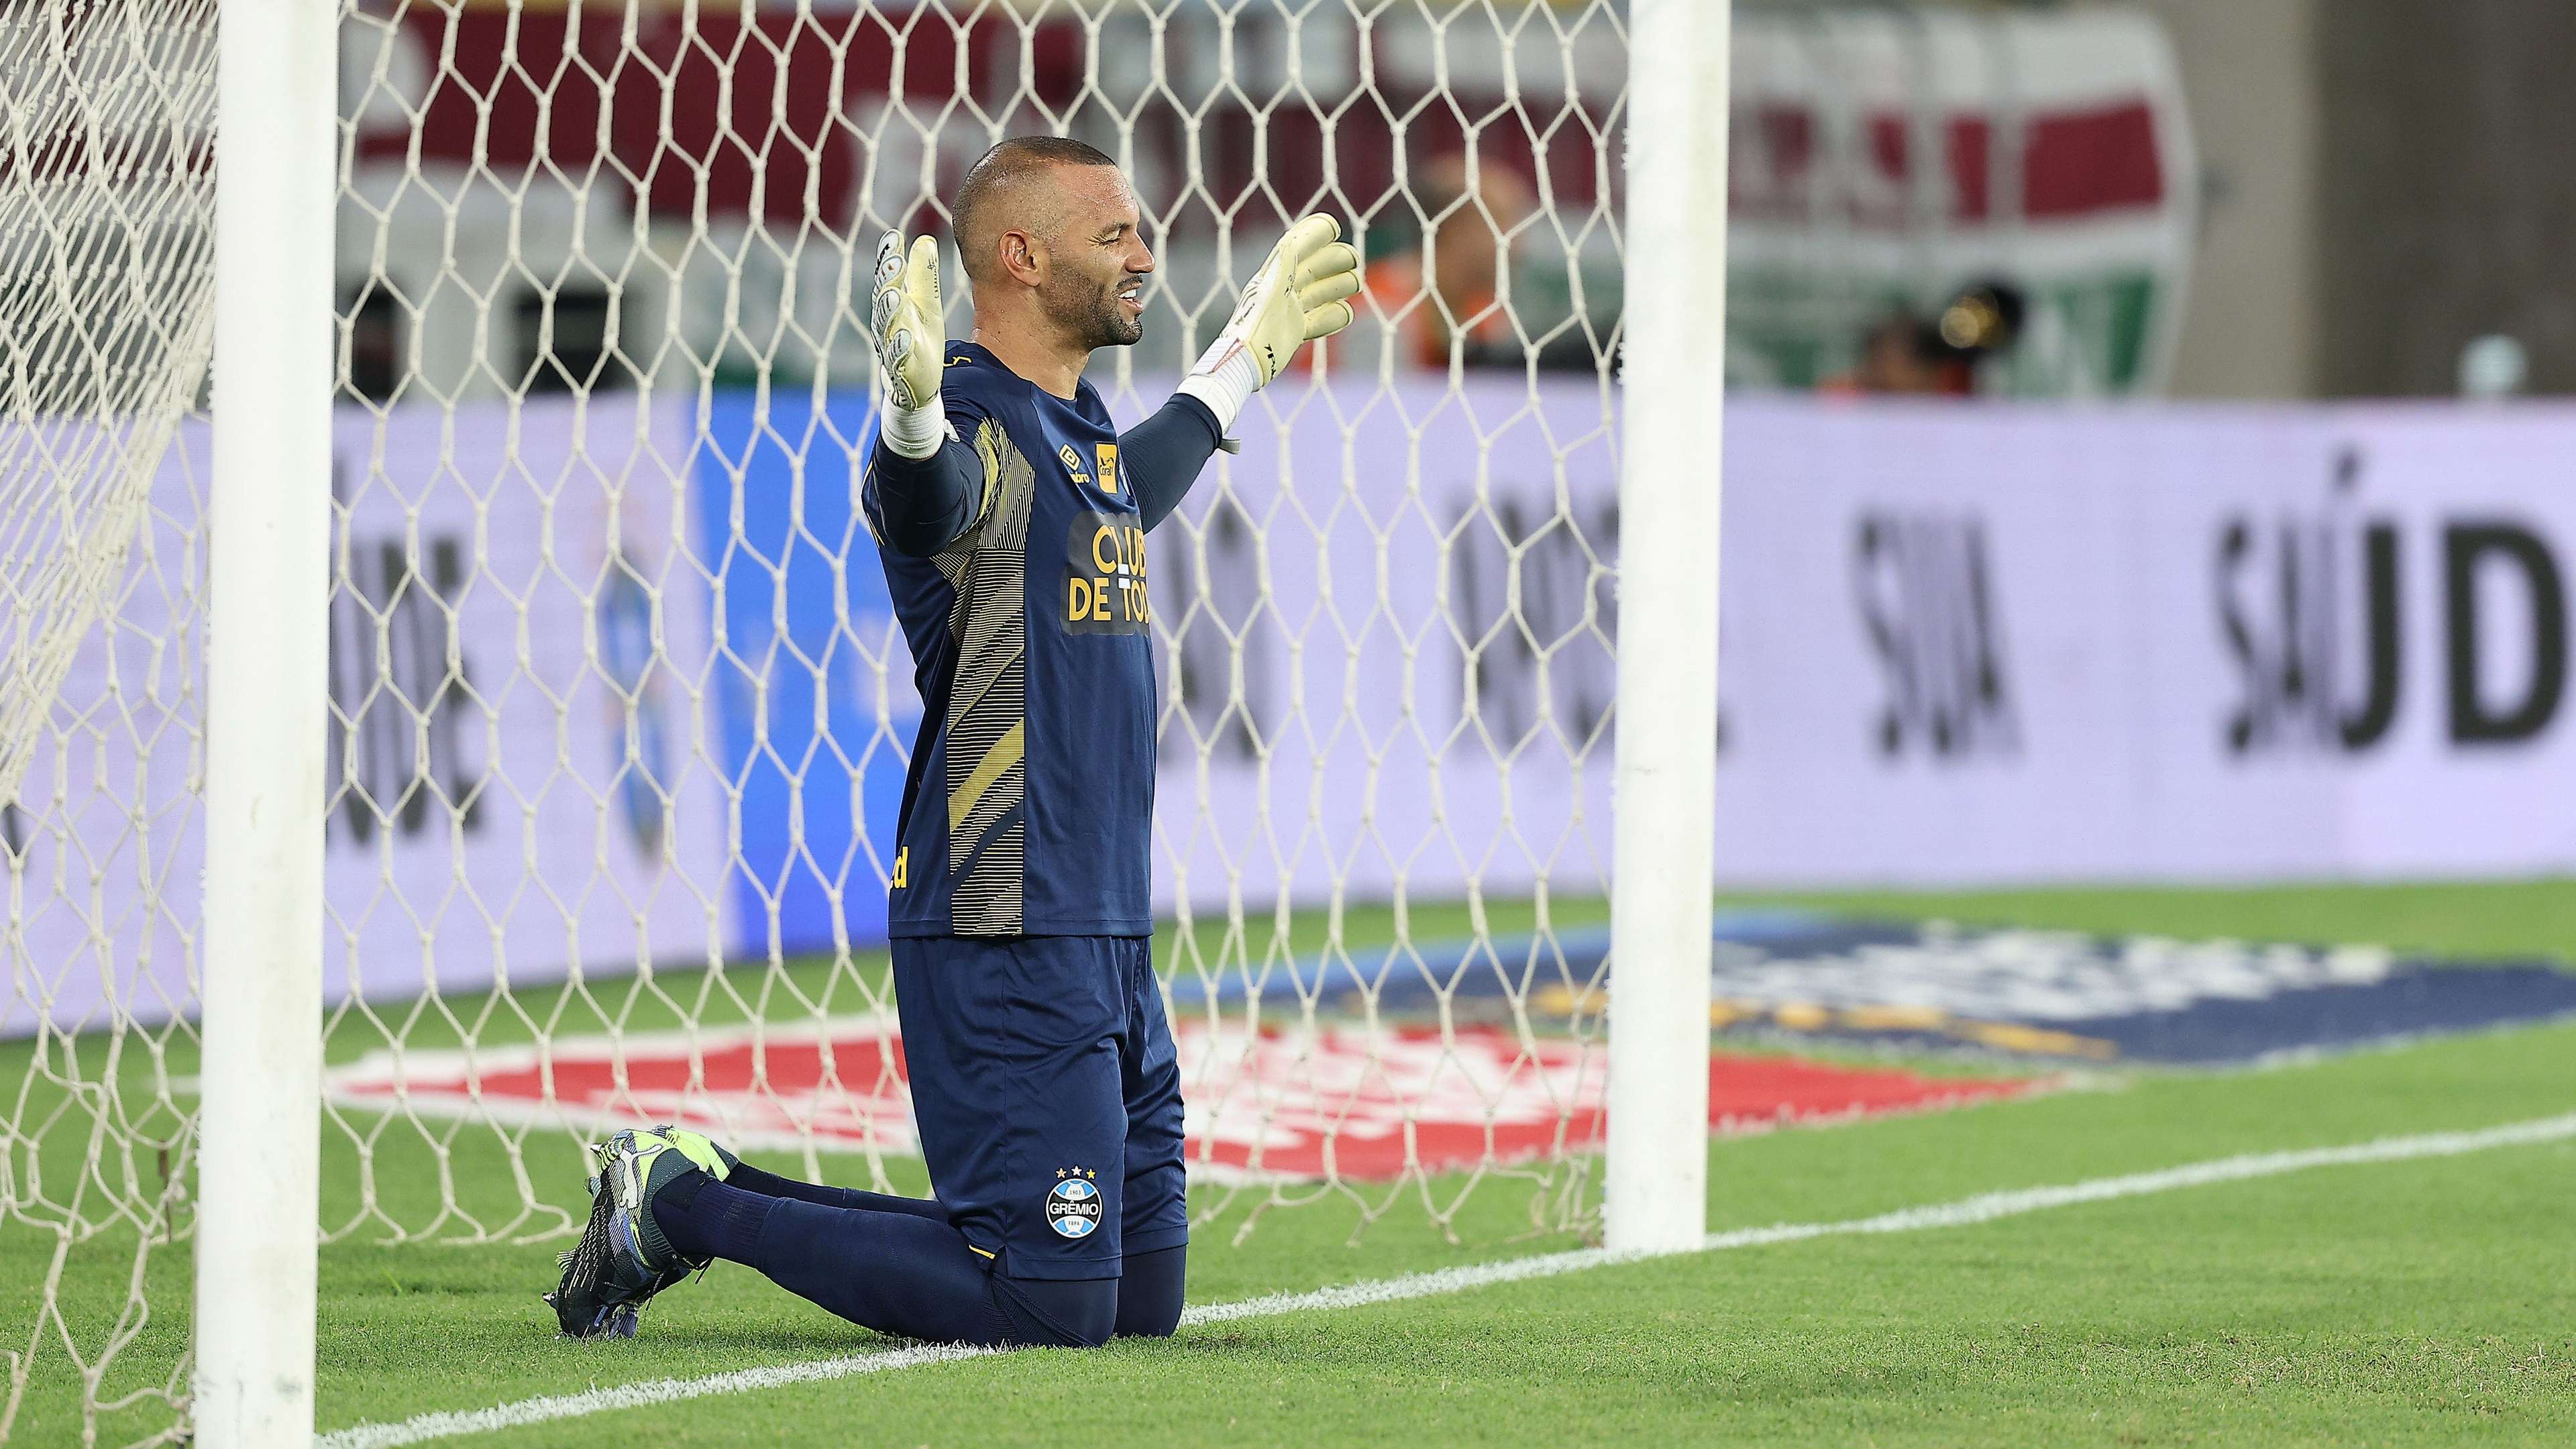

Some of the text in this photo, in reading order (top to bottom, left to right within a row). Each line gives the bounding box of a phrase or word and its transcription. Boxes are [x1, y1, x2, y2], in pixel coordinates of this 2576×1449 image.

[1099, 465, 1112, 476] Coral
[1069, 577, 1112, 621] DE
[1049, 1200, 1099, 1216] GRÊMIO
